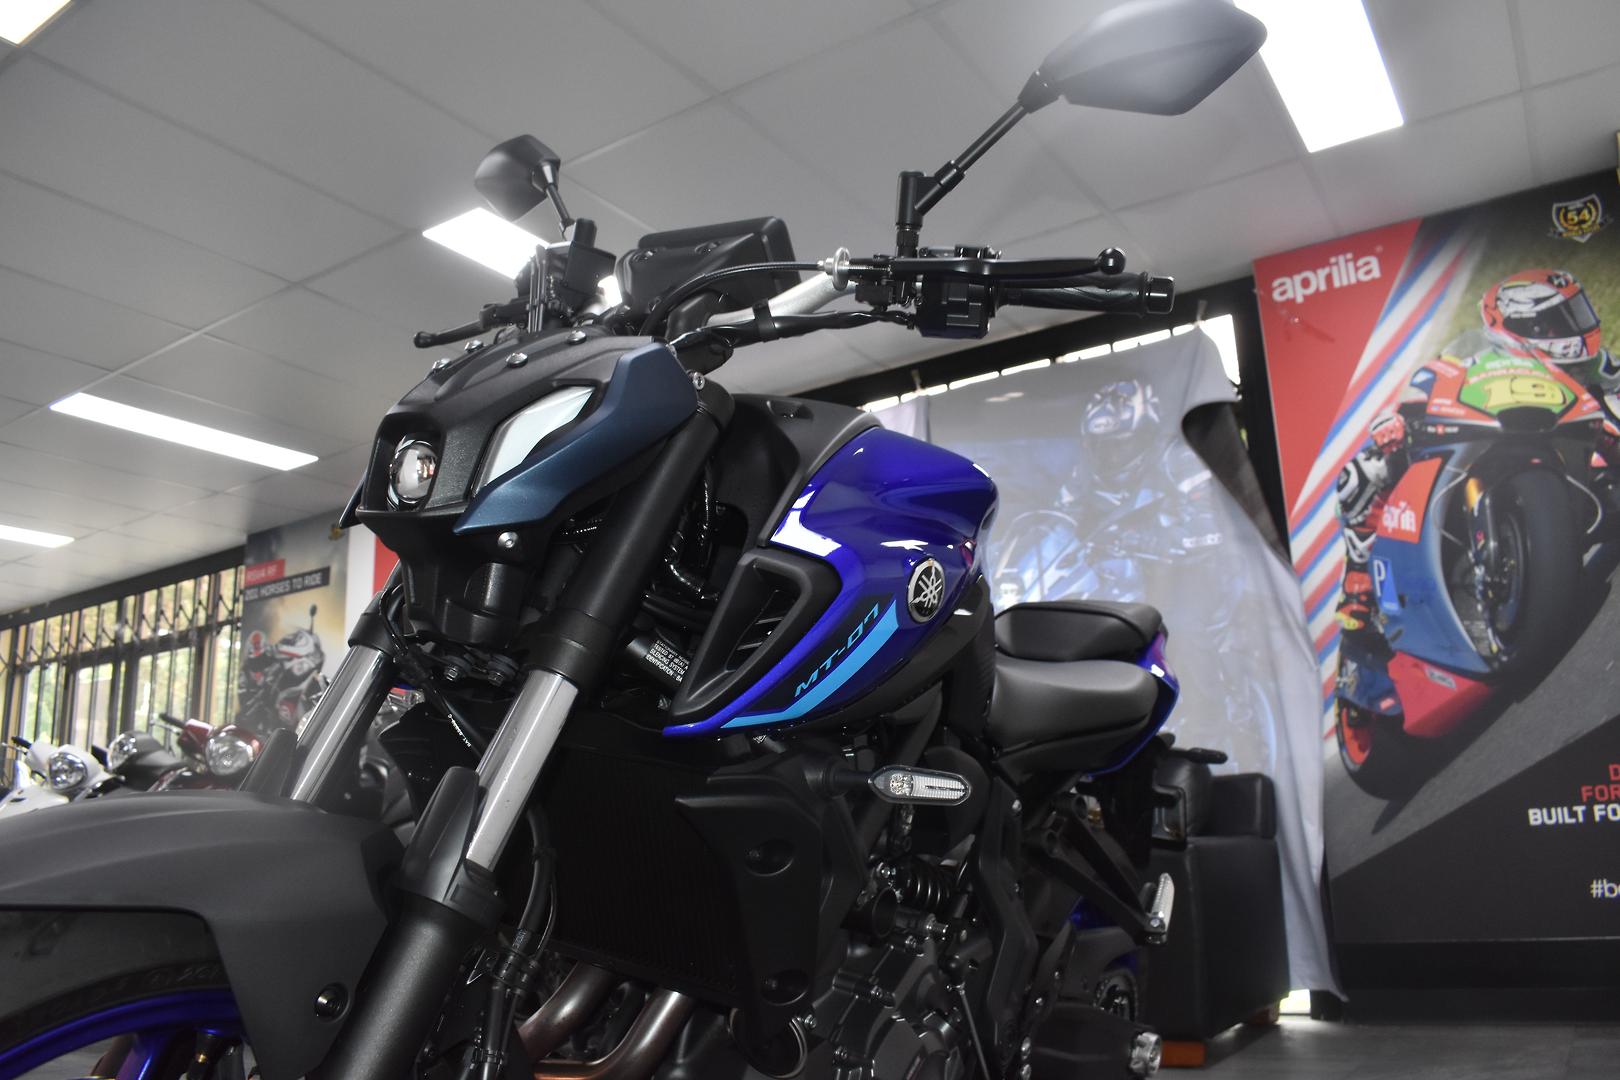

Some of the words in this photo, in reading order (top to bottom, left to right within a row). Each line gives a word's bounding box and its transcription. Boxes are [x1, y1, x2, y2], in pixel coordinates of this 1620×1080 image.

[1567, 207, 1591, 224] 54
[1271, 252, 1381, 304] aprilia
[260, 579, 290, 597] HORSES
[291, 576, 304, 589] TO
[304, 571, 323, 587] RIDE
[649, 648, 670, 665] SILENCING
[669, 661, 685, 675] SYSTEM
[795, 602, 879, 698] MT-07
[1581, 783, 1620, 803] FOR
[1527, 805, 1587, 826] BUILT
[1590, 878, 1620, 899] #b
